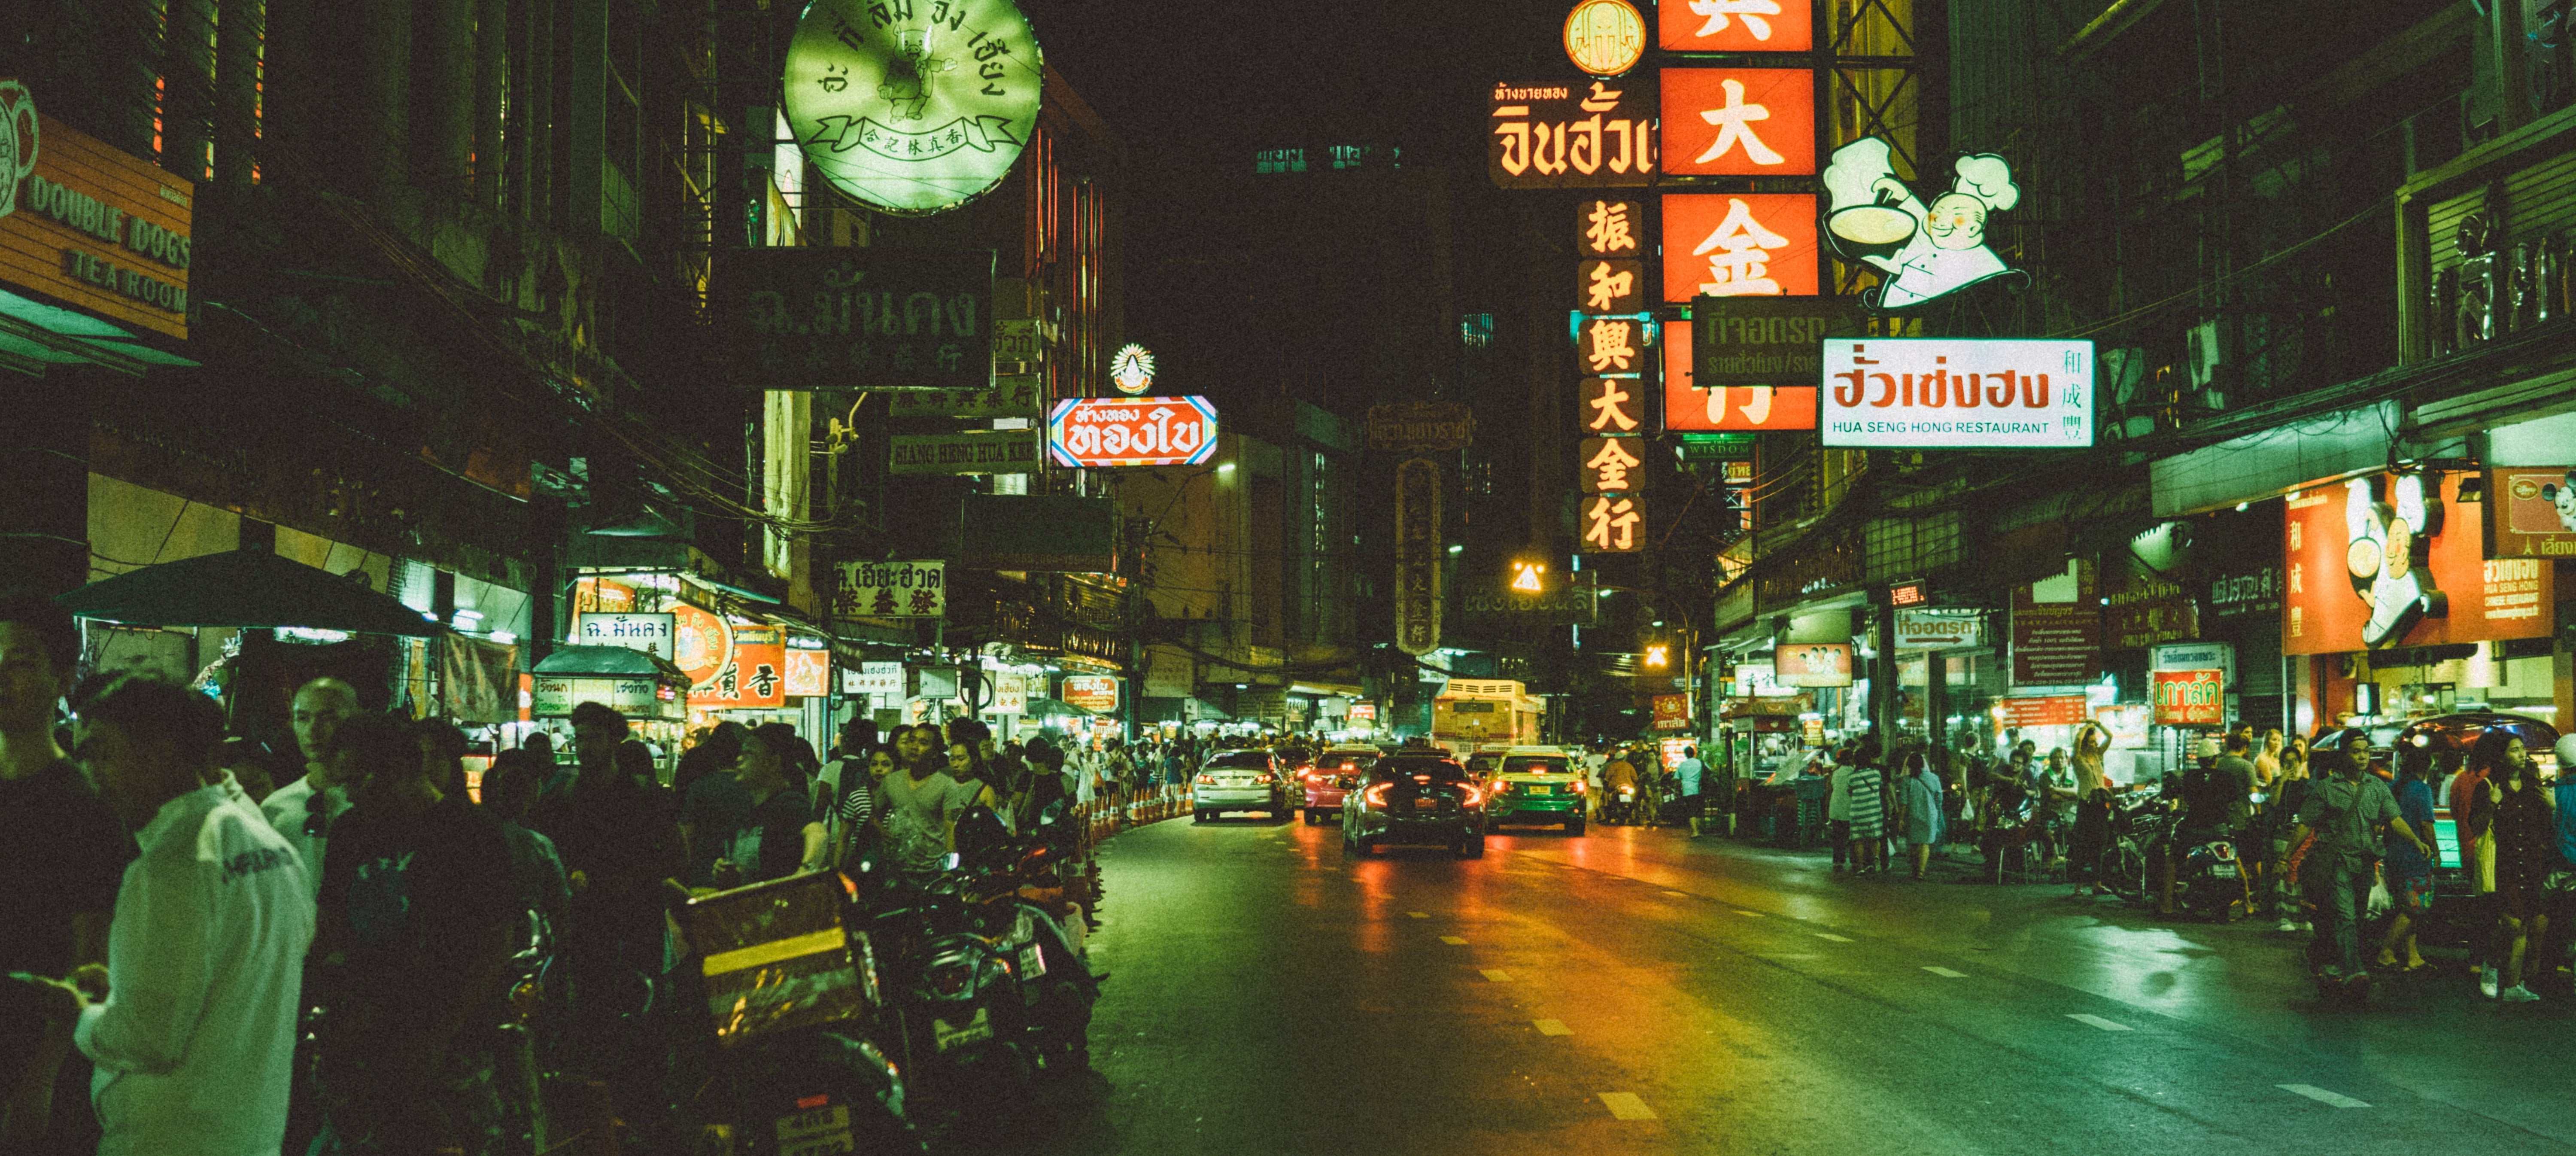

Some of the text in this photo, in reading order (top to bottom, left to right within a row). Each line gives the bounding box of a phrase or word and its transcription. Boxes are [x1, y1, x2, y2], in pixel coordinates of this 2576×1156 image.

[1495, 82, 1568, 101] ห้างขายทอง
[1492, 82, 1657, 176] จินฮั้วเ
[30, 175, 191, 269] DOUBLE DOGS
[71, 250, 187, 312] TEA ROOM
[1586, 200, 1640, 550] 振和興大金行
[1833, 344, 2050, 409] ฮั่วเซ่งฮง
[1067, 407, 1200, 456] ทองใบ
[1833, 421, 2050, 434] HUA SENG HONG RESTAURANT
[896, 441, 1034, 465] SIANG HENG HUA KEE
[1689, 445, 1750, 453] WISDOM
[2541, 534, 2576, 555] เลี่ยง
[2484, 580, 2539, 594] HUA SENG HONG
[2155, 672, 2219, 706] เกาลัด
